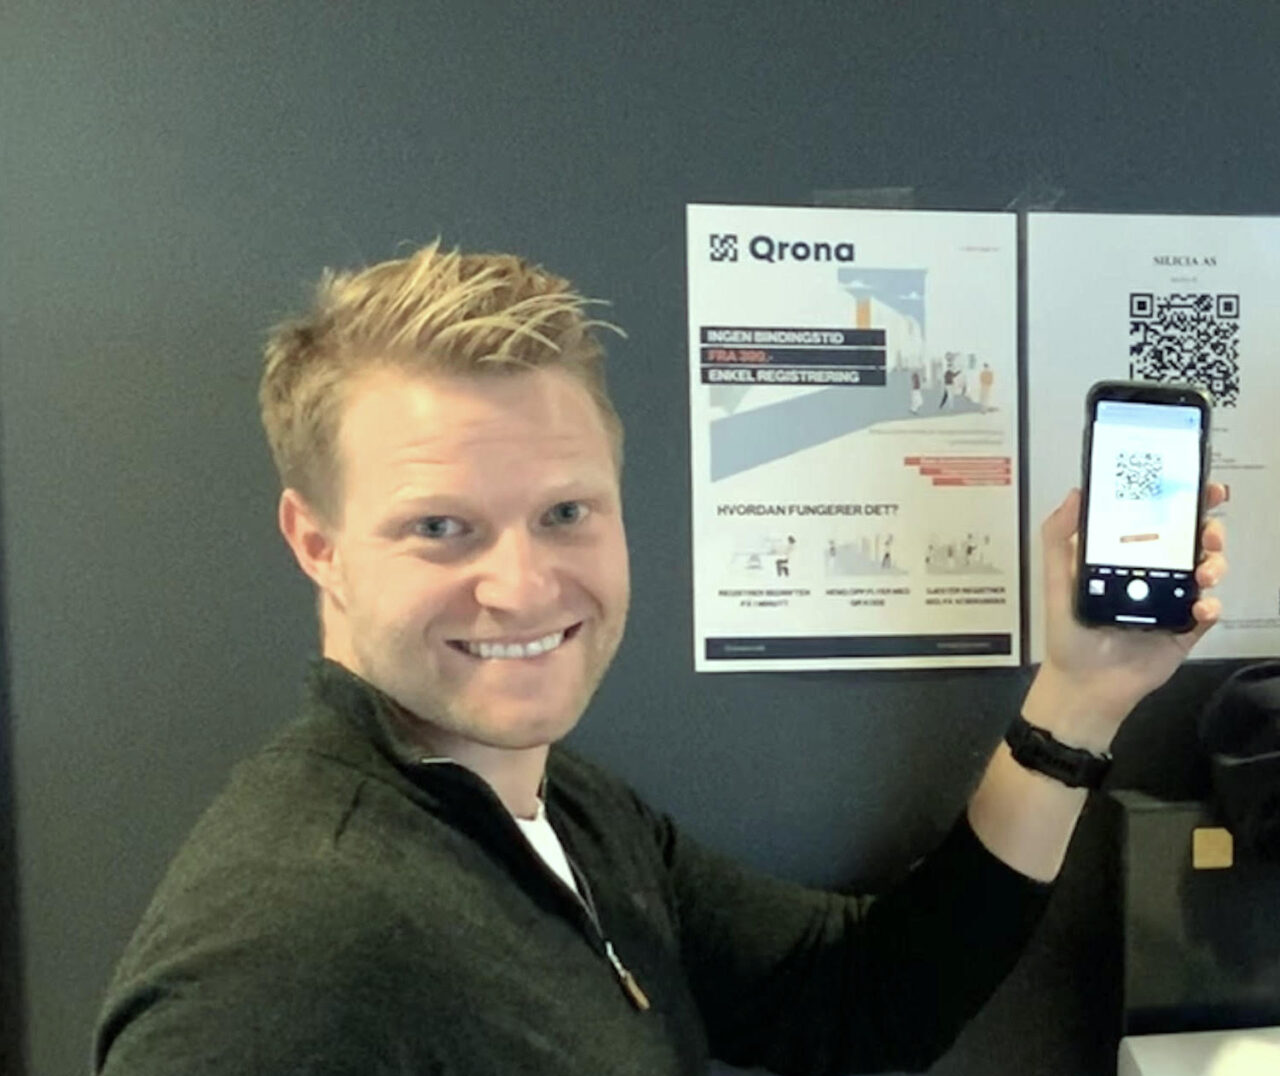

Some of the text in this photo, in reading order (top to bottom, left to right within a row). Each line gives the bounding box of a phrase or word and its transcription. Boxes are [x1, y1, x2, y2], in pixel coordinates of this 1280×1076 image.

[749, 235, 855, 263] Qrona
[706, 330, 845, 344] INGEN BINDINGSTID
[708, 369, 861, 383] ENKEL REGISTRERING
[717, 503, 899, 516] HVORDAN FUNGERER DET?
